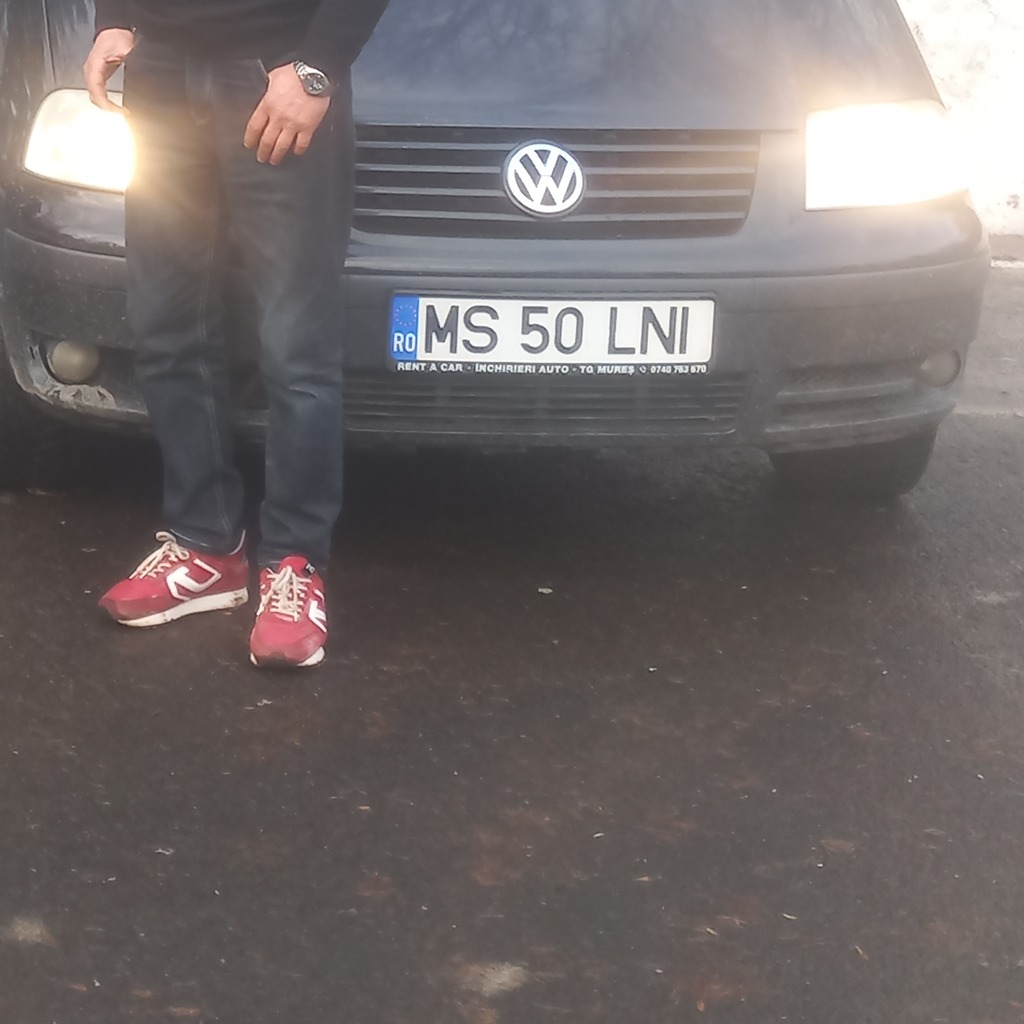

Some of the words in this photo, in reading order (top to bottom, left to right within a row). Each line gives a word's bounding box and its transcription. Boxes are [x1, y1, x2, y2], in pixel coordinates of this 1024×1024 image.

[425, 304, 499, 355] MS
[520, 305, 584, 355] 50
[607, 306, 689, 356] LNI
[392, 332, 416, 354] RO
[397, 362, 426, 372] RENT
[429, 363, 437, 372] A
[440, 363, 463, 372] CAR
[538, 364, 569, 374] AUTO
